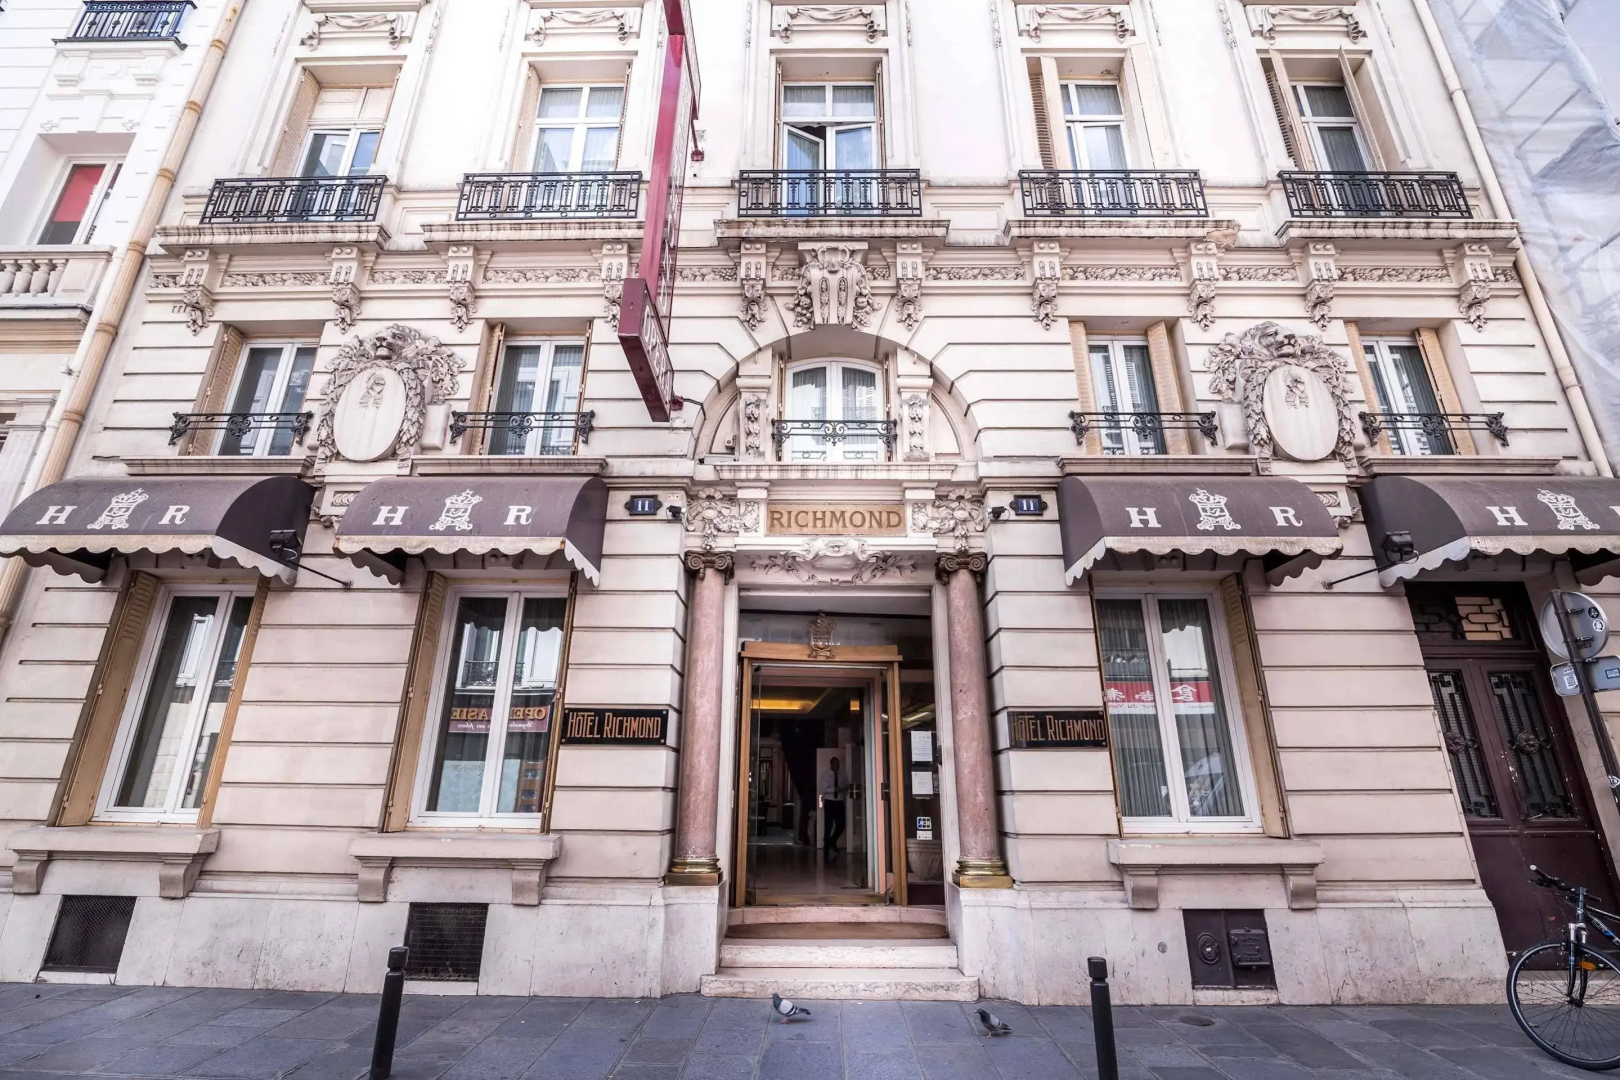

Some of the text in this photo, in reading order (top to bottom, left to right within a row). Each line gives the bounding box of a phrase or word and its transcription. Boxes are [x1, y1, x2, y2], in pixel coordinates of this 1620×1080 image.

[36, 505, 190, 525] H R
[637, 499, 649, 511] 11
[1022, 499, 1035, 511] 11
[372, 505, 532, 526] H R
[769, 510, 903, 529] RICHMOND
[1125, 506, 1303, 527] H R
[1486, 506, 1528, 526] H
[603, 712, 661, 738] RICHMOND
[1046, 715, 1105, 741] RICHMOND
